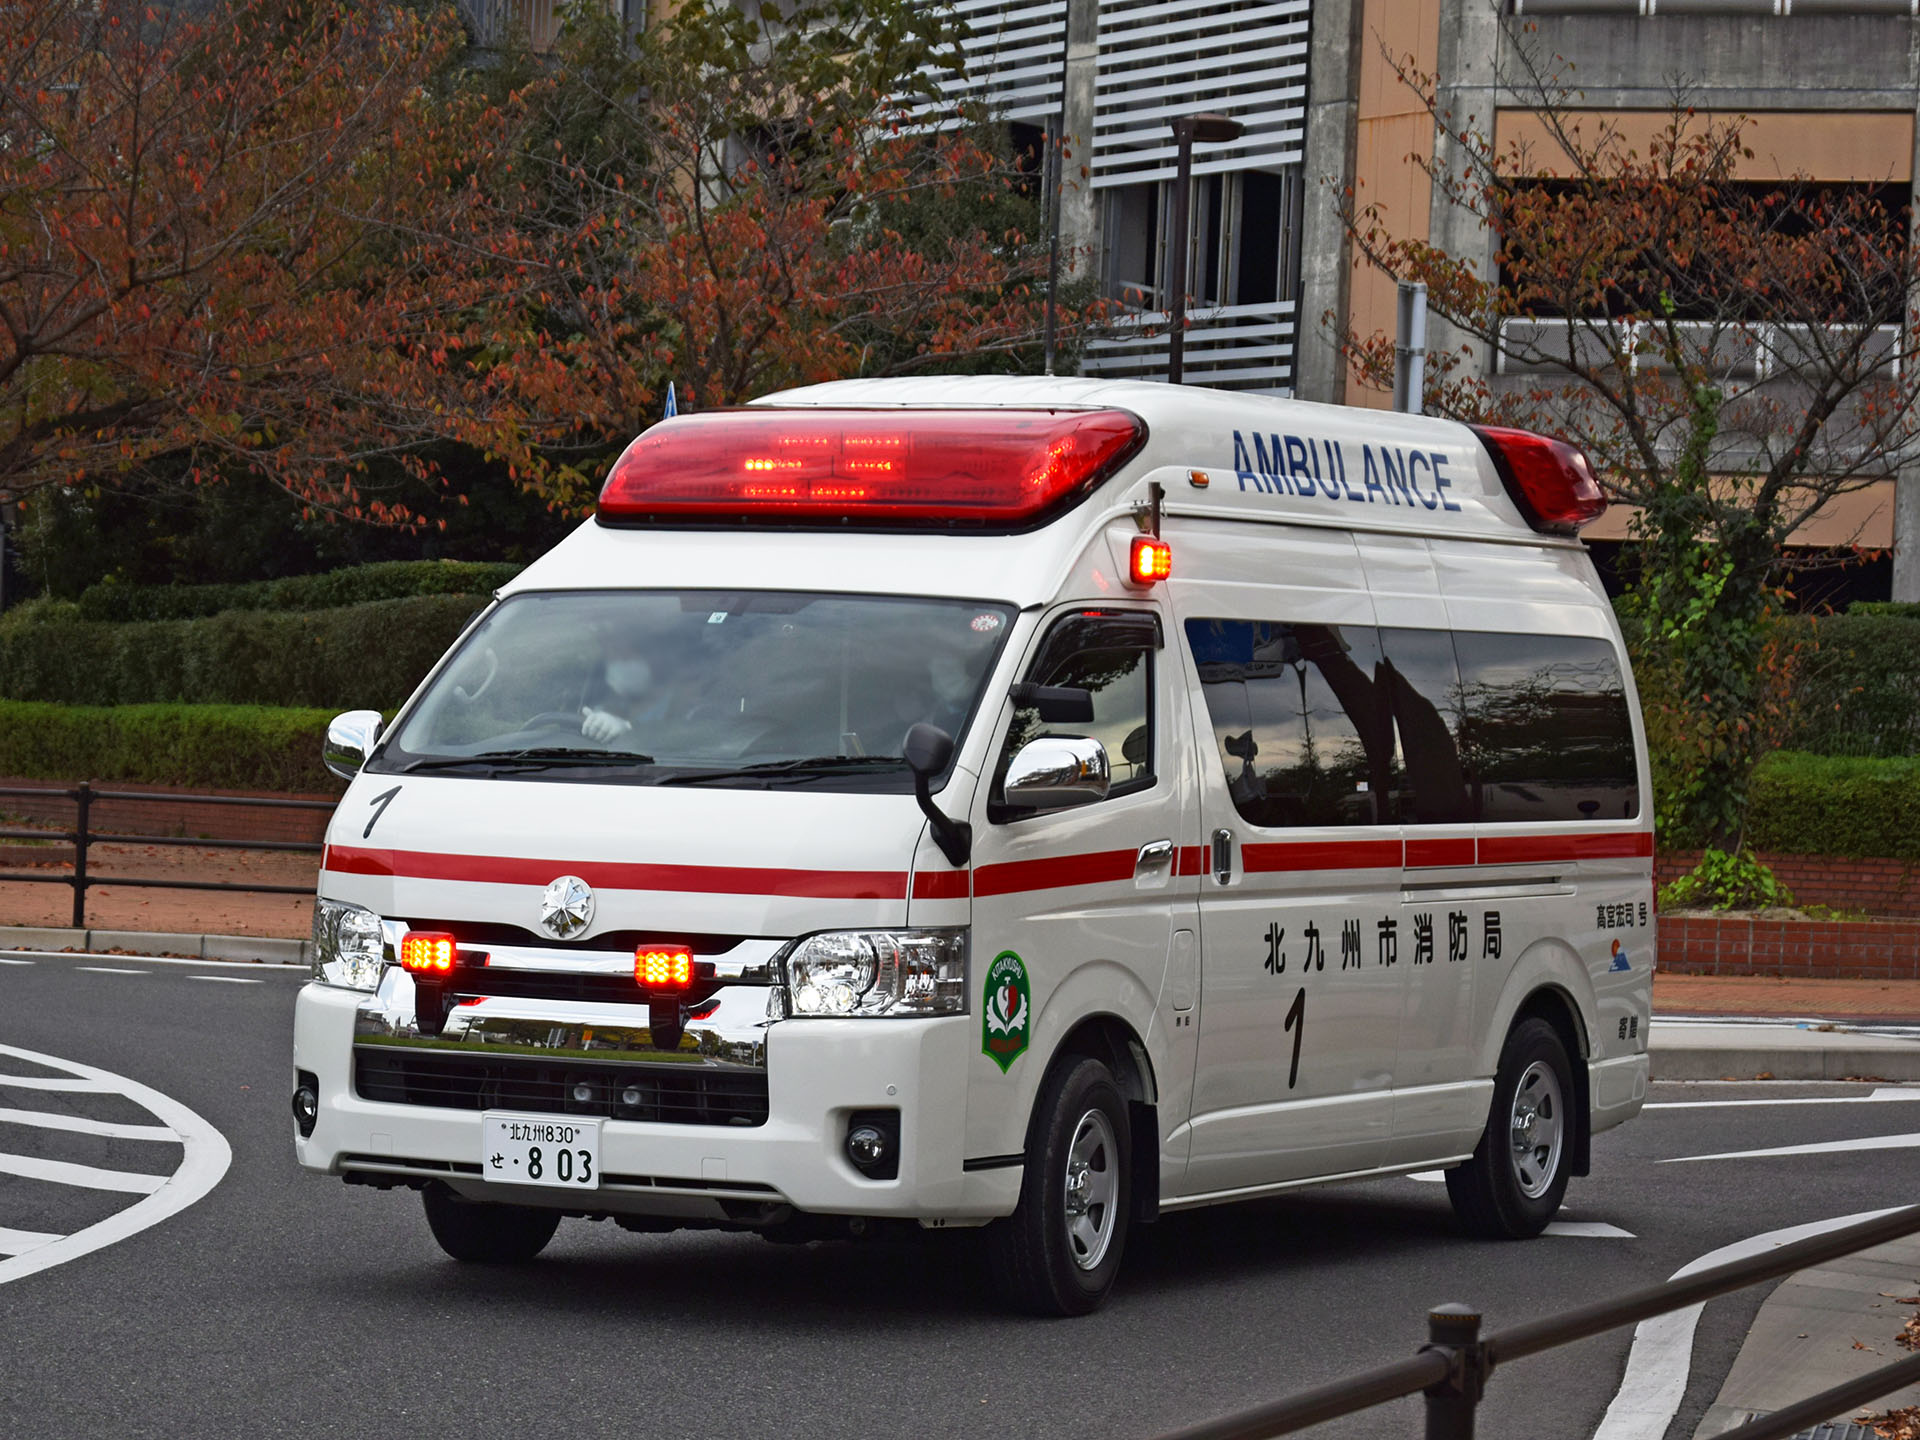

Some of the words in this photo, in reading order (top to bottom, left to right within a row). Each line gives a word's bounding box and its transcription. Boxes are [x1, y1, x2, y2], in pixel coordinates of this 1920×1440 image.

[1233, 430, 1462, 512] AMBULANCE
[363, 785, 403, 839] 1
[1264, 910, 1501, 975] 北九州市消防局
[1284, 987, 1305, 1089] 1
[490, 1152, 504, 1169] せ
